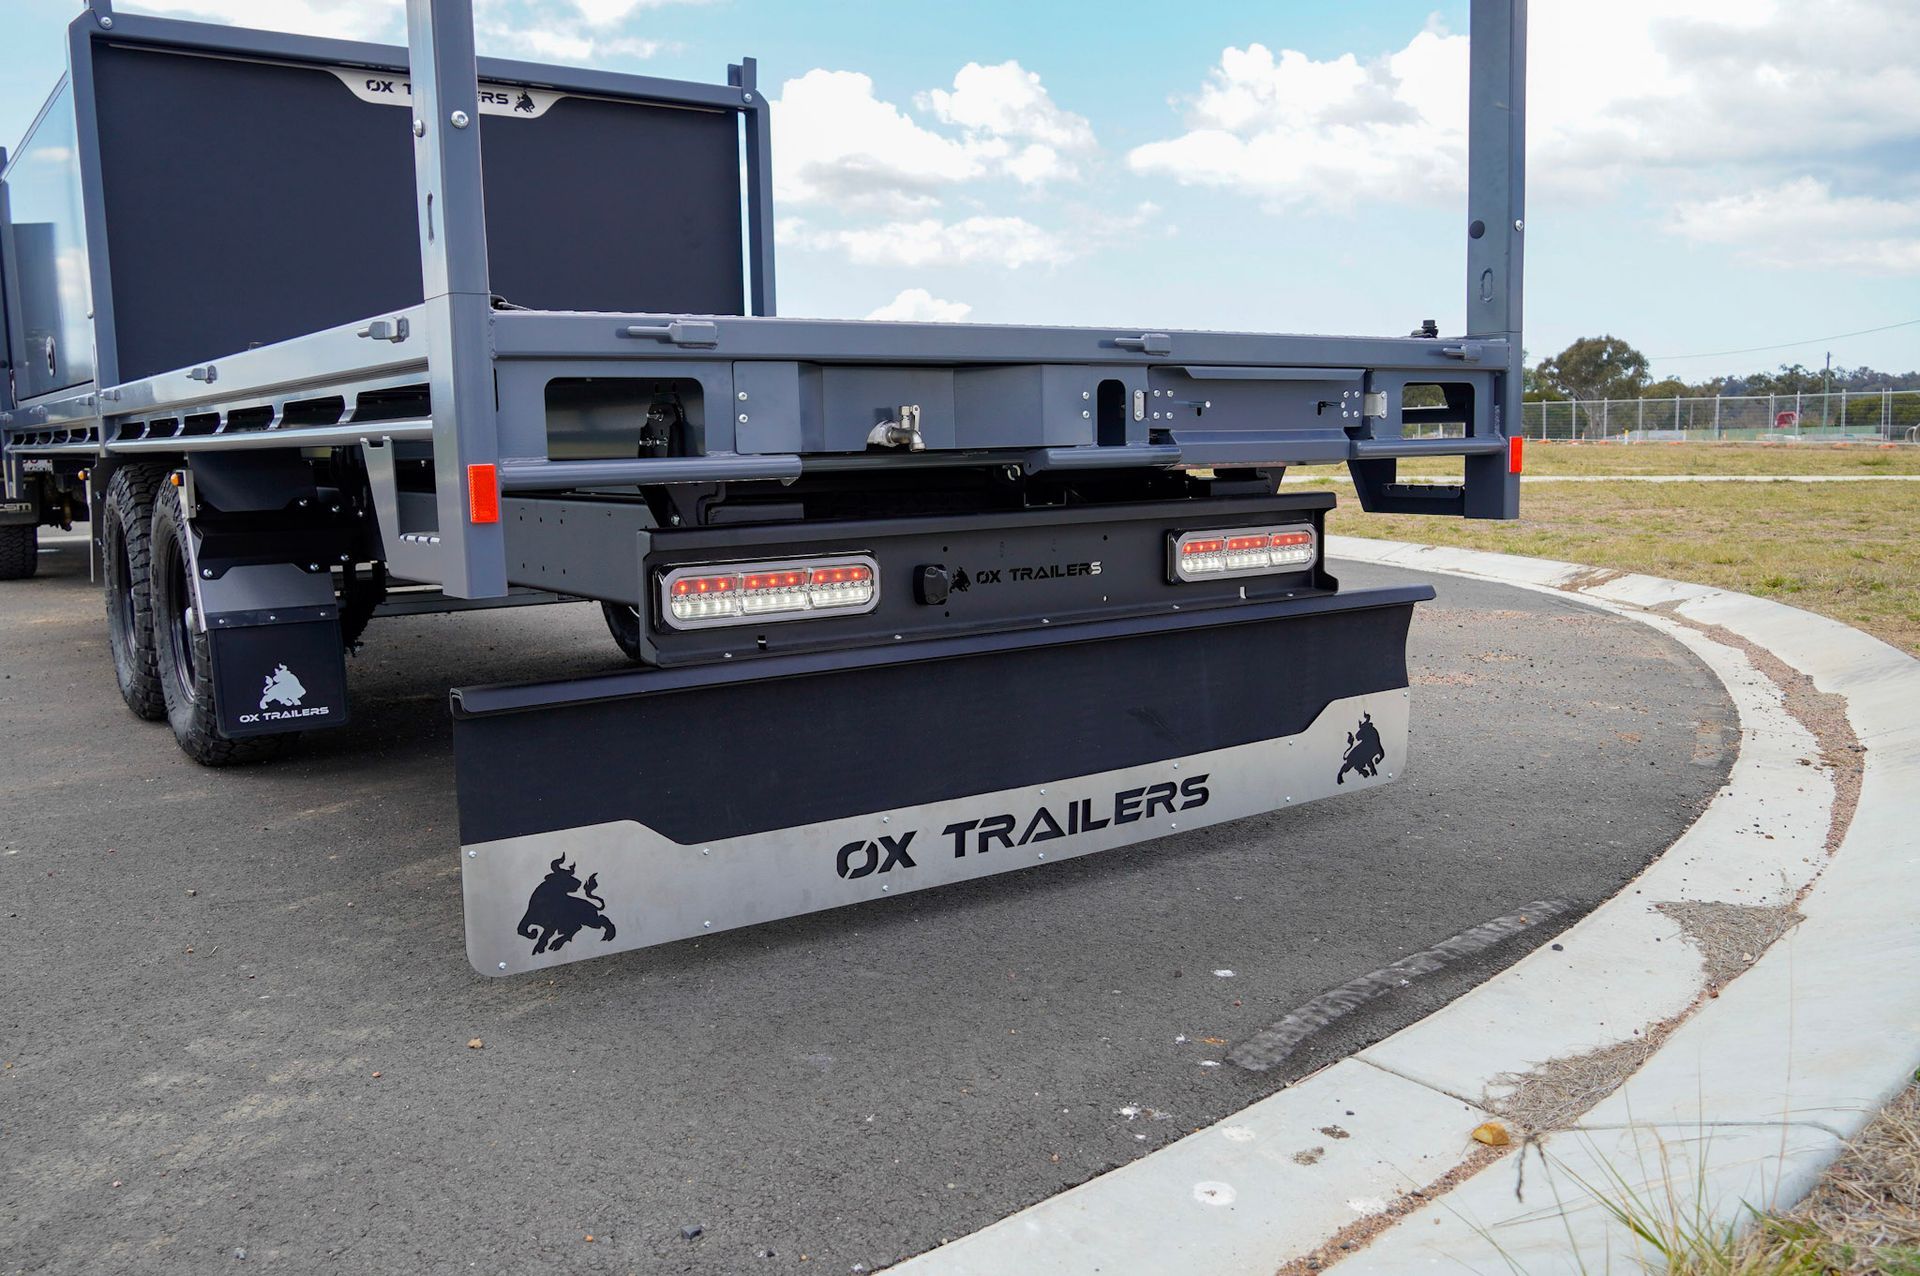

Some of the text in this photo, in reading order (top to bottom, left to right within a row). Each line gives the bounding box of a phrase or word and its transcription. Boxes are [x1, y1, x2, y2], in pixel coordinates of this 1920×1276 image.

[366, 79, 394, 93] OX
[975, 561, 1103, 584] OX TRAILERS
[240, 706, 329, 723] OX TRAILERS
[836, 773, 1210, 880] OX TRAILERS
